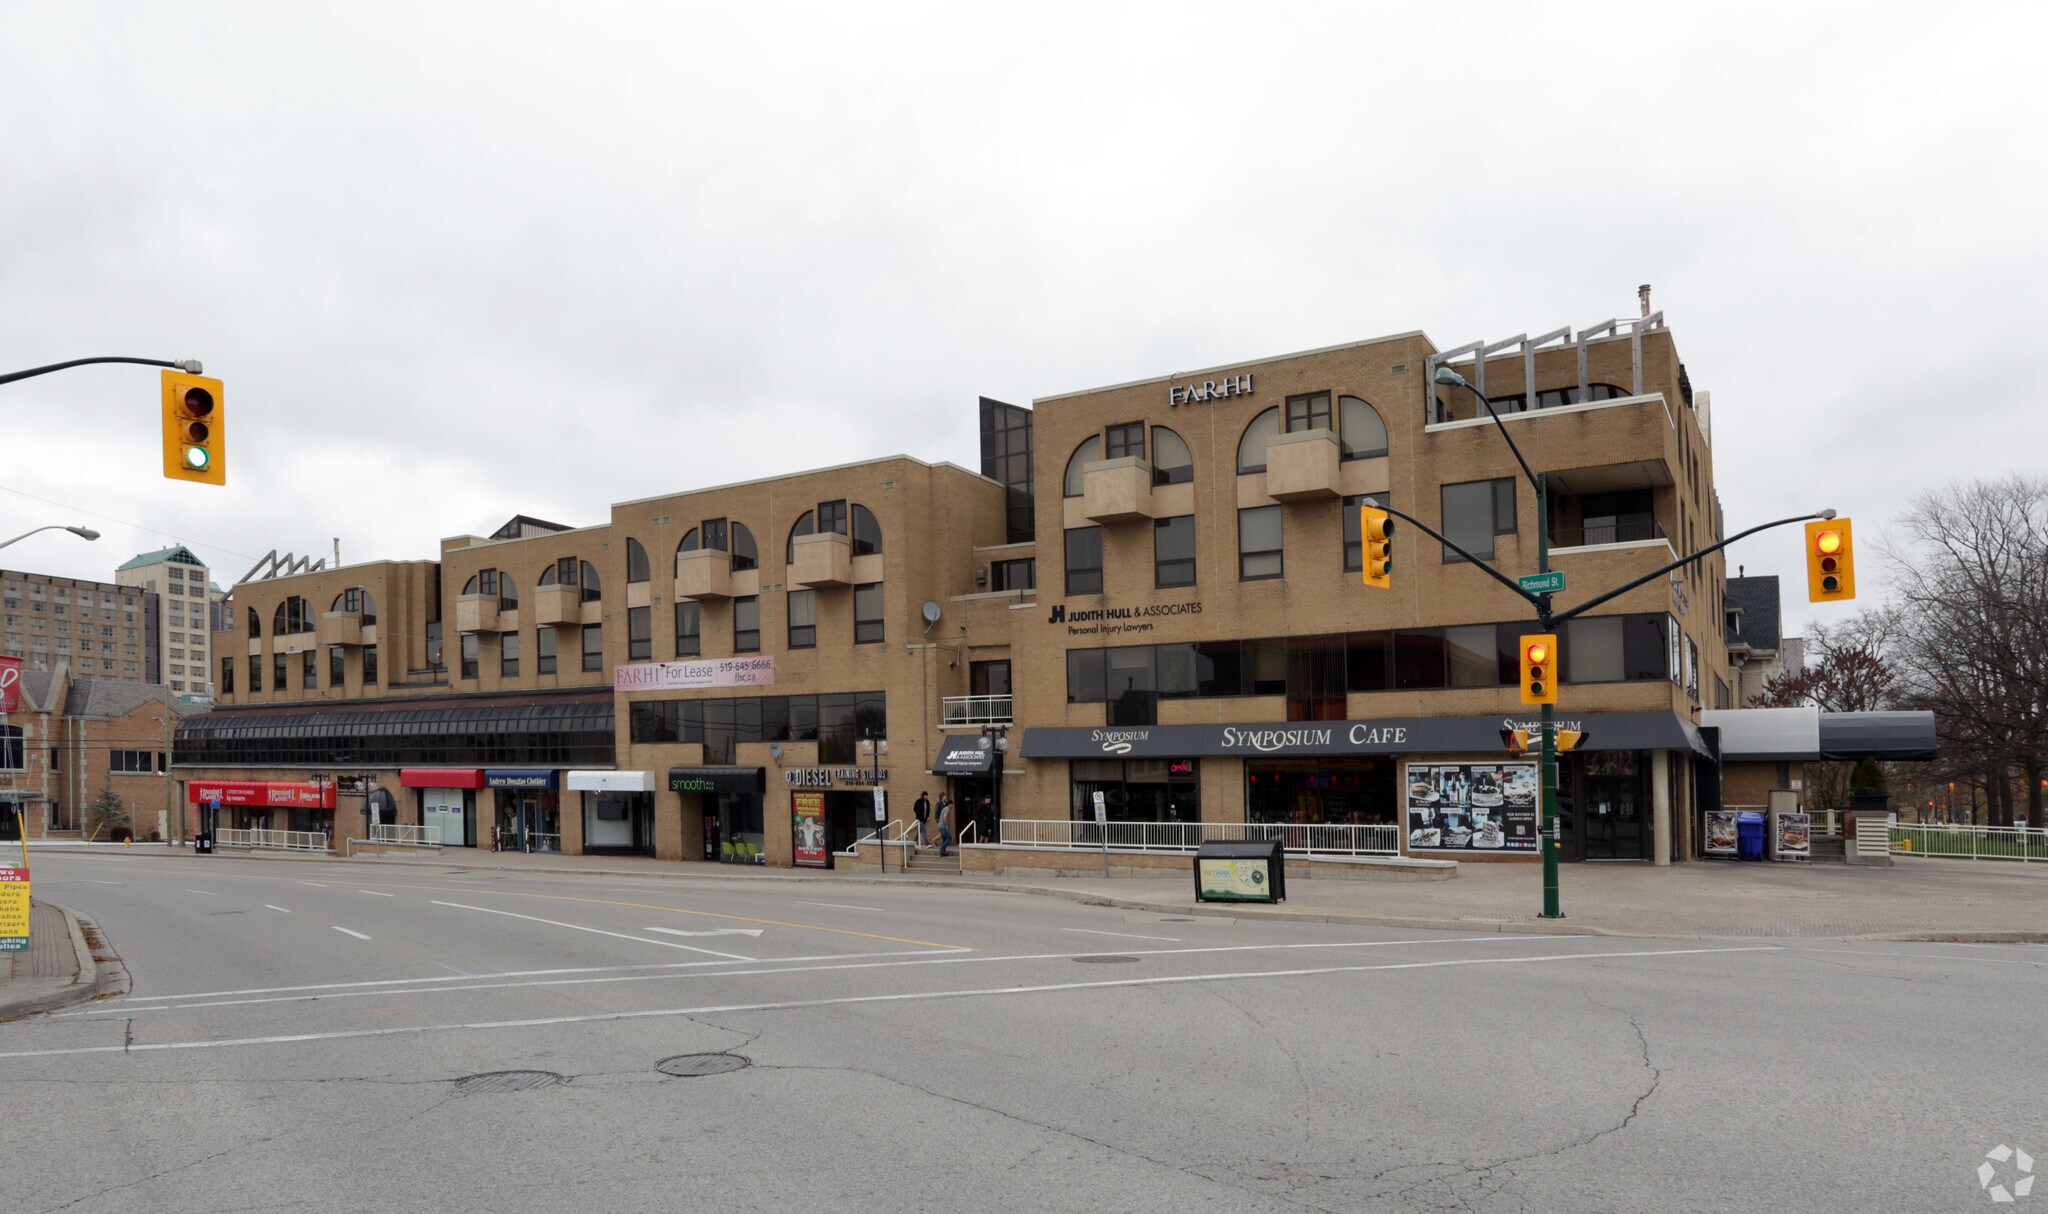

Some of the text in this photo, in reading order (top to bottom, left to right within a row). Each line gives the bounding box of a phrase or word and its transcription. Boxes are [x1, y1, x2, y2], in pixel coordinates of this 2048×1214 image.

[1169, 374, 1253, 407] FARHI
[1522, 576, 1559, 590] Richmond St.
[1068, 603, 1203, 623] JUDITH HULL & ASSOCIATES
[1068, 621, 1154, 636] Personal Injury Lawyers
[666, 665, 713, 679] For Lease
[719, 660, 771, 673] 519-645-6666
[616, 667, 659, 684] FARHI
[1091, 729, 1149, 743] SYMPOSIUM
[1221, 724, 1407, 751] SYMPOSIUM CAFE
[672, 777, 706, 790] smooth
[795, 768, 832, 786] DIESEL
